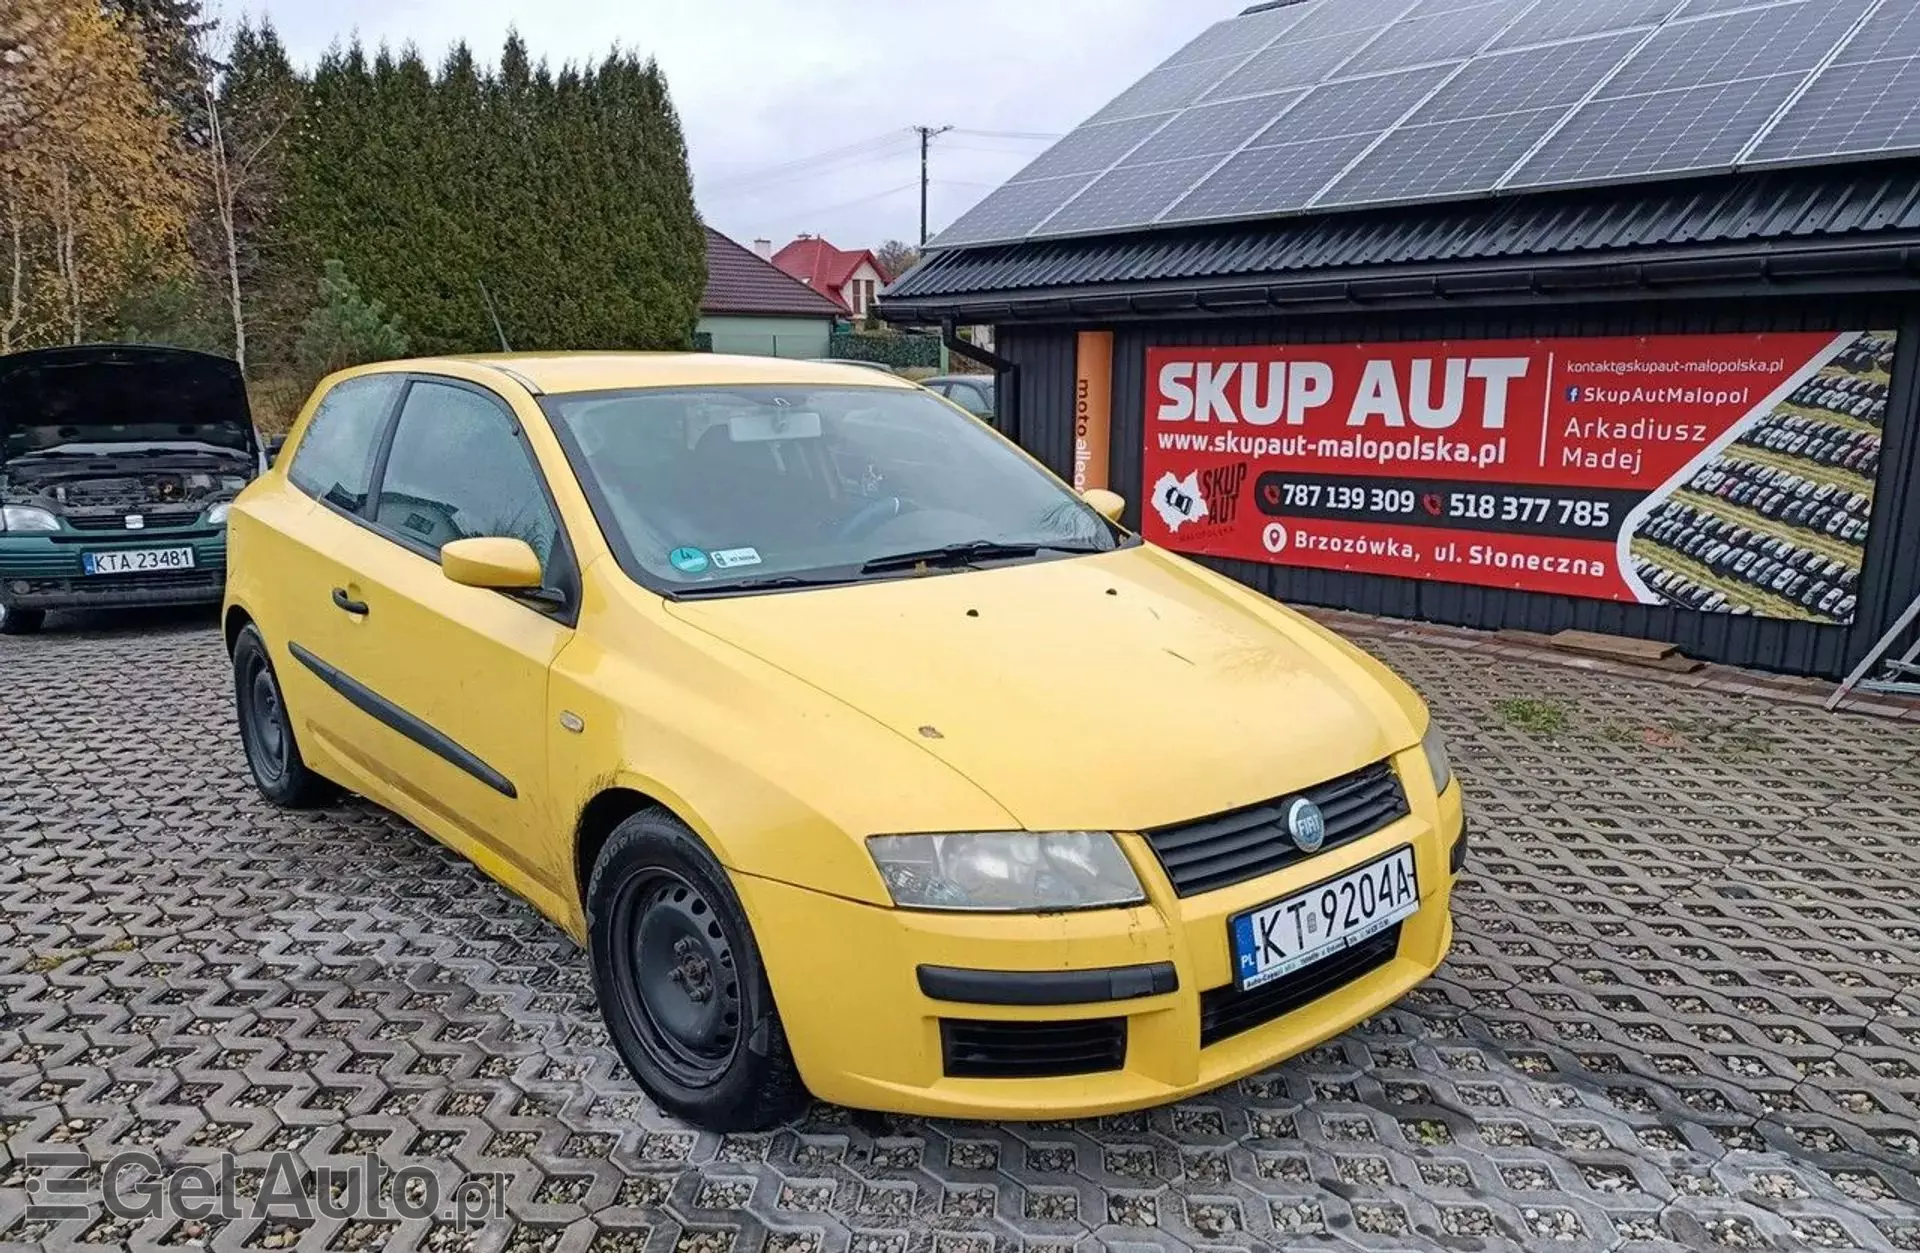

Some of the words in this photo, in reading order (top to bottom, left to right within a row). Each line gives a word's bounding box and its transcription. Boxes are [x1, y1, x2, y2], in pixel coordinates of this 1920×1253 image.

[1157, 360, 1334, 425] SKUP
[1346, 357, 1530, 429] AUT
[1583, 386, 1749, 405] SkupAutMalopol
[1564, 417, 1707, 442] Arkadiusz
[1158, 430, 1506, 468] www.skupaut-malopolska.pl
[1562, 447, 1643, 475] Madej
[1202, 462, 1248, 500] SKUP
[1207, 492, 1240, 526] AUT
[1282, 484, 1320, 508] 787
[1325, 486, 1364, 511] 139
[1369, 489, 1415, 514] 309
[1449, 494, 1495, 520] 518
[1500, 496, 1550, 522] 377
[1557, 499, 1610, 527] 785
[95, 554, 131, 572] KTA
[136, 550, 189, 568] 23481
[1295, 530, 1421, 562] Brzozówka,
[1434, 542, 1462, 564] ul.
[1469, 546, 1605, 577] Słoneczna
[1297, 814, 1320, 837] FIAT
[1260, 901, 1306, 965] KT
[1321, 858, 1412, 938] 9204A
[1240, 955, 1255, 968] PL
